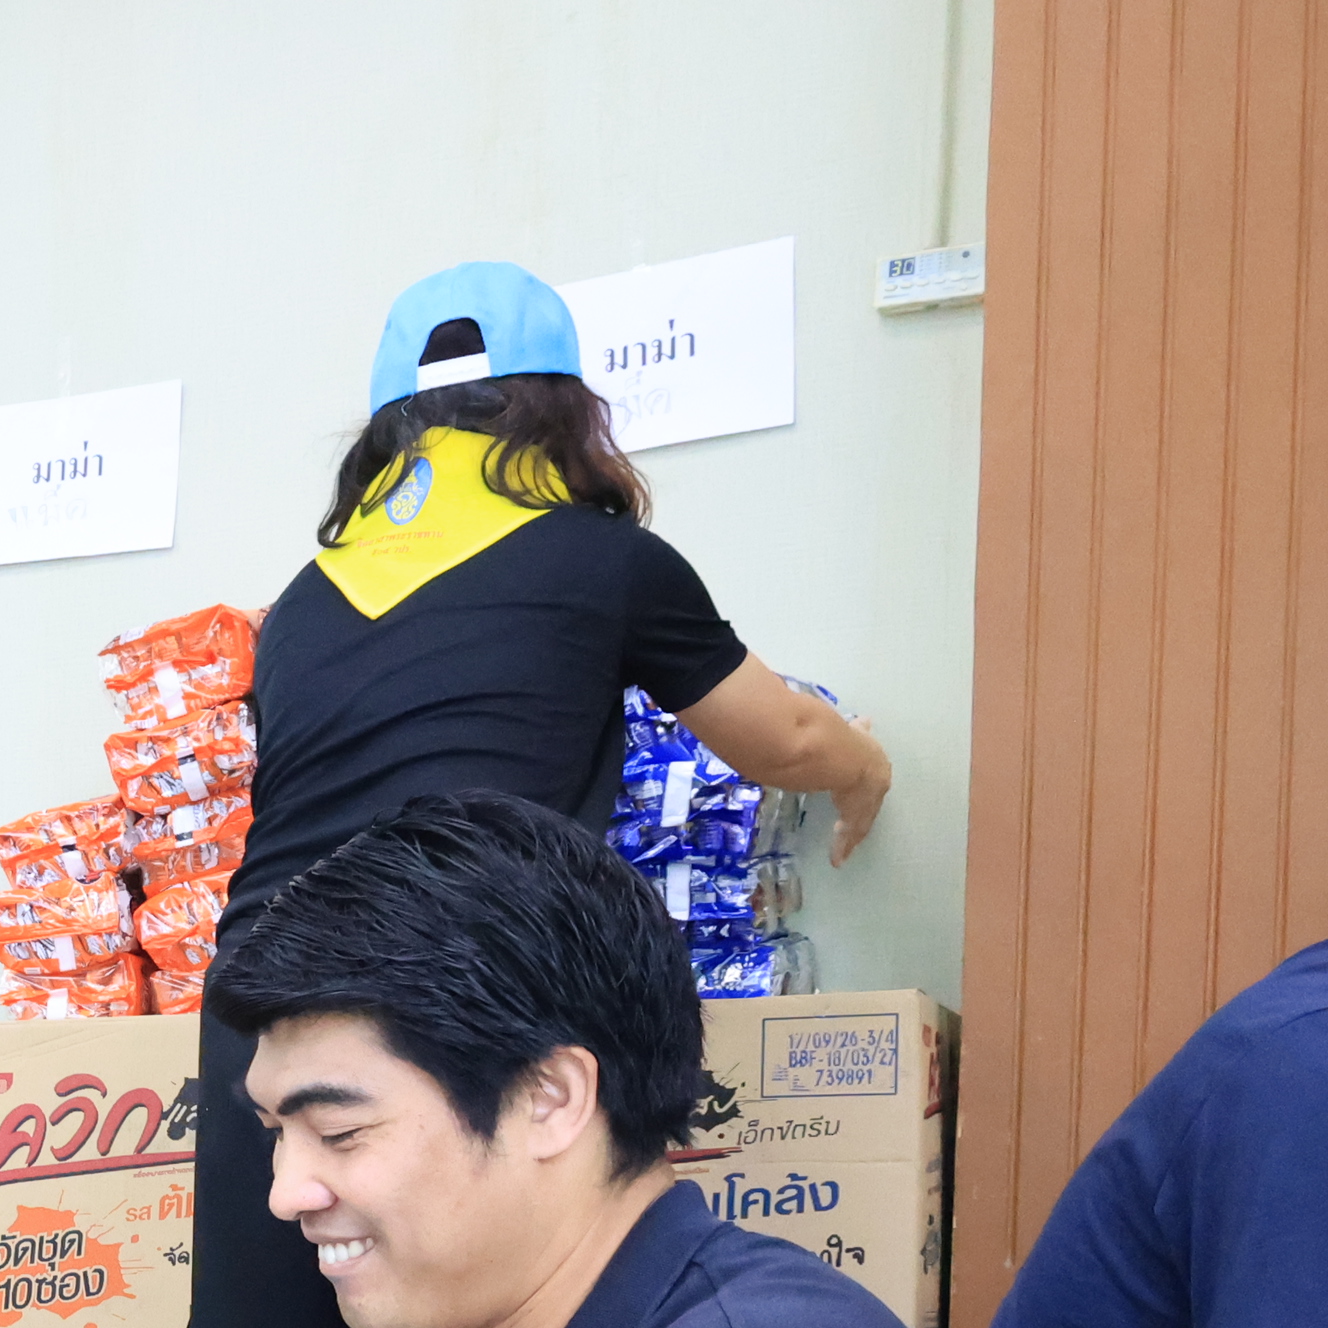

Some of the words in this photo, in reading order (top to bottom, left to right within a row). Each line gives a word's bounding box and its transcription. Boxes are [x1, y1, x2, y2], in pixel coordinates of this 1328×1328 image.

[603, 318, 697, 373] มาม่า
[32, 439, 104, 485] มาม่า
[814, 1068, 873, 1086] 739891
[125, 1204, 152, 1222] รส
